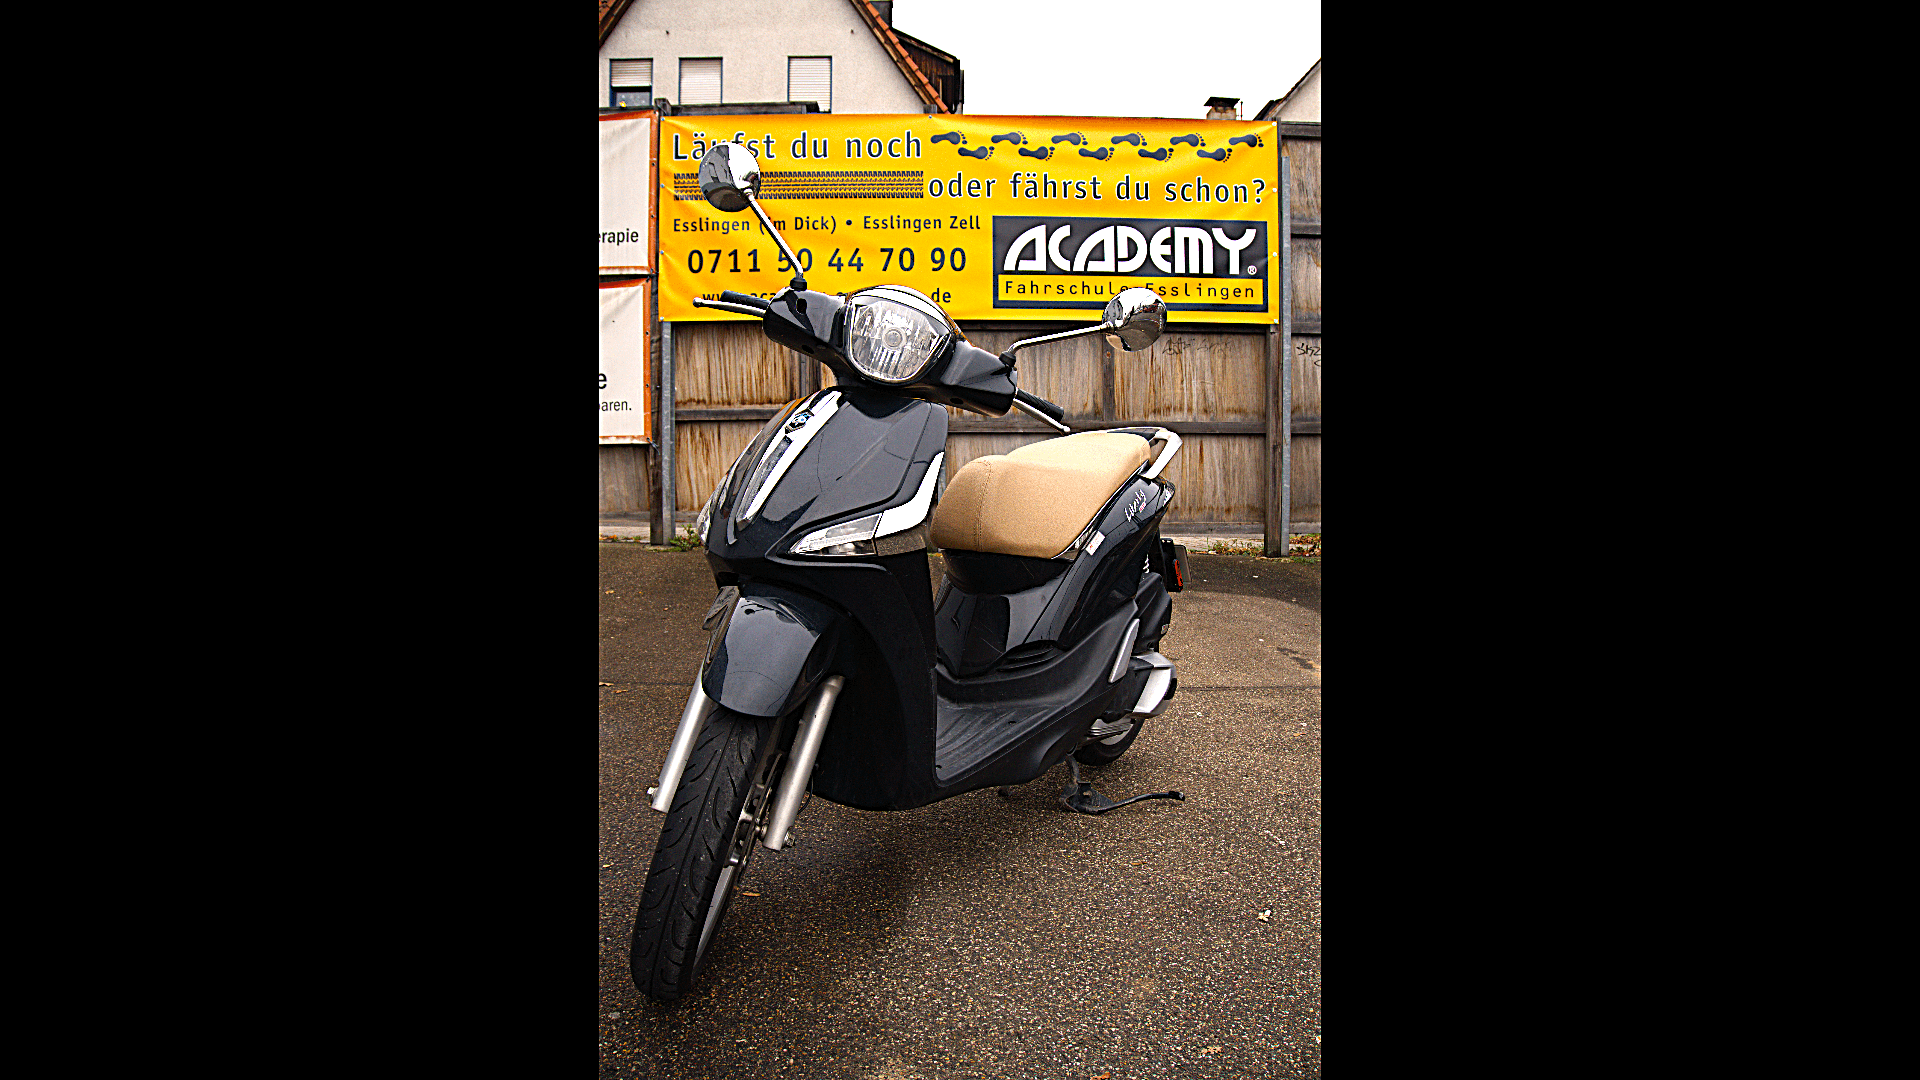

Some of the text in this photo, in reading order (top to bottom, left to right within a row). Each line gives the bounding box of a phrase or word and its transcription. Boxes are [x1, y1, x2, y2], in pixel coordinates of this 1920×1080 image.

[673, 130, 921, 160] Läfst du noch
[929, 172, 1266, 204] oder fährst du schon?
[599, 228, 639, 246] rapie
[673, 214, 981, 235] Esslingen (m Dick) Esslingen Zell
[688, 247, 966, 274] 0711 50 44 70 90
[1003, 224, 1257, 275] ACADEMY
[599, 401, 632, 411] aren.
